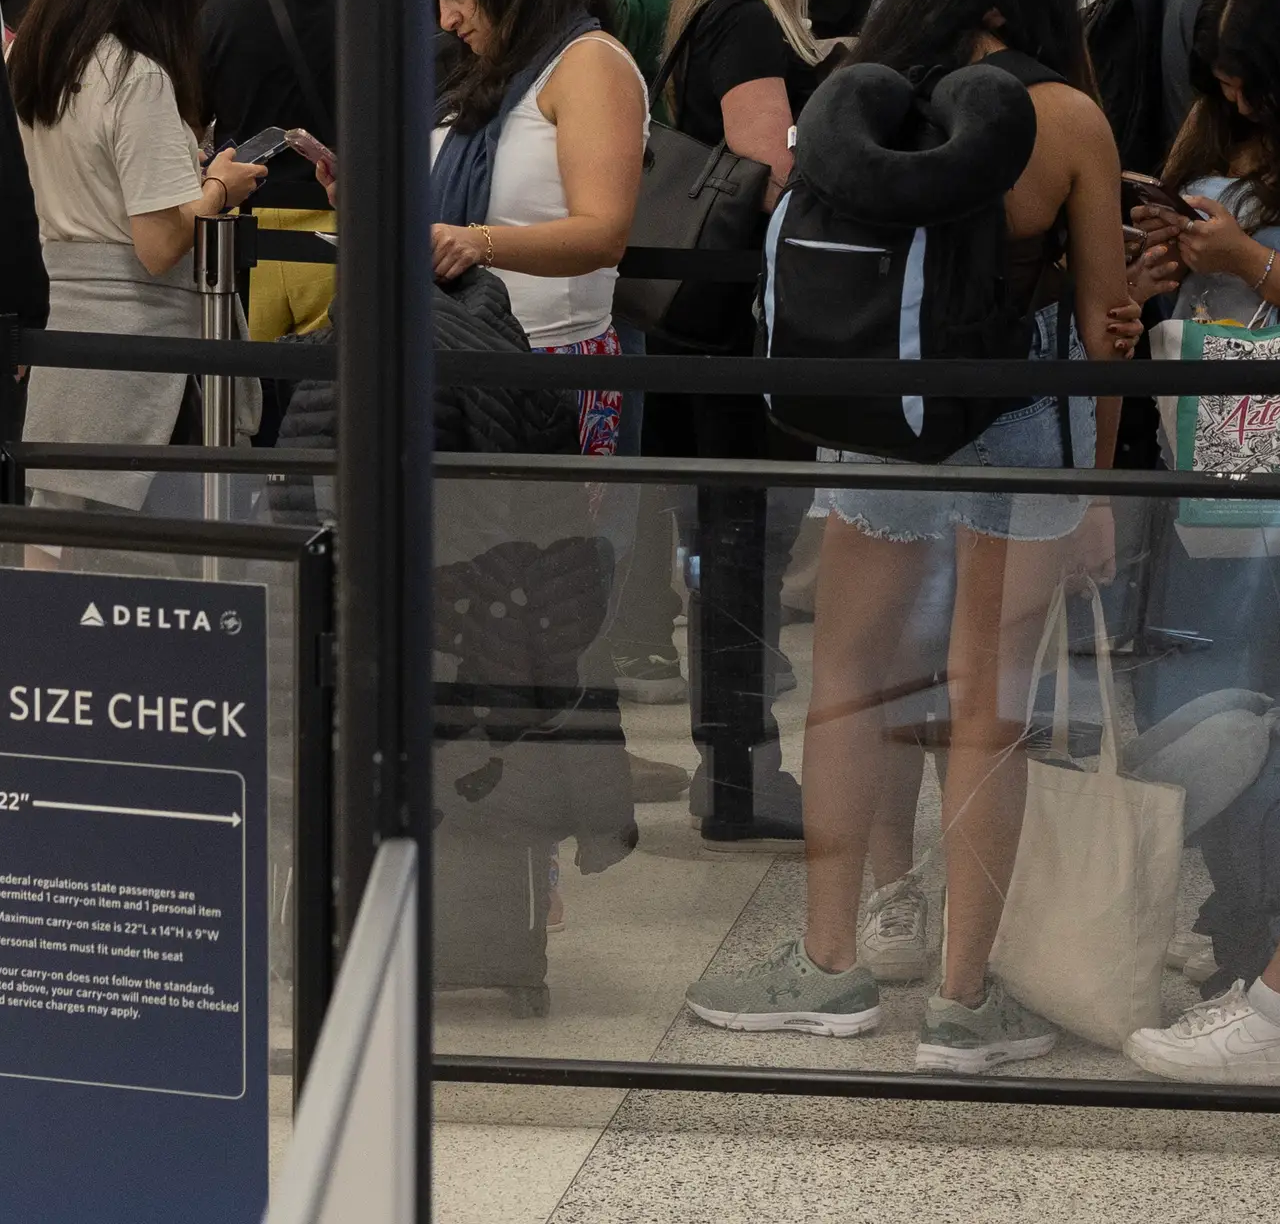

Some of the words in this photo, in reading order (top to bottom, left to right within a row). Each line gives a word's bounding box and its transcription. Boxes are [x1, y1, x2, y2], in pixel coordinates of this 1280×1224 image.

[113, 604, 212, 632] DELTA
[9, 685, 93, 726] SIZE
[107, 692, 247, 739] CHECK
[33, 877, 89, 891] regulations
[91, 882, 116, 894] state
[119, 885, 176, 900] passengers
[178, 891, 195, 901] are
[46, 892, 51, 902] 1
[53, 894, 96, 907] carry-on
[98, 897, 121, 909] item
[124, 900, 142, 911] and
[144, 900, 150, 911] 1
[152, 903, 196, 916] personal
[198, 905, 222, 917] item
[46, 917, 89, 930] carry-on
[91, 920, 111, 932] size
[113, 921, 122, 933] is
[150, 926, 157, 936] x
[186, 929, 193, 939] x
[39, 938, 68, 952] items
[69, 941, 95, 954] must
[97, 942, 109, 955] fit
[111, 945, 141, 958] under
[143, 947, 160, 960] the
[161, 951, 184, 962] seat
[21, 968, 64, 981] carry-on
[65, 970, 91, 984] does
[92, 974, 110, 986] not
[111, 974, 143, 988] follow
[144, 978, 162, 990] the
[163, 981, 215, 996] standards
[7, 997, 44, 1010] service
[45, 999, 86, 1014] charges
[87, 1005, 109, 1017] may
[110, 1006, 141, 1020] apply.
[16, 982, 49, 996] above,
[51, 987, 74, 997] your
[76, 989, 119, 1002] carry-on
[122, 991, 139, 1003] will
[141, 994, 167, 1006] need
[168, 996, 180, 1008] to
[181, 997, 195, 1009] be
[196, 998, 240, 1013] checked
